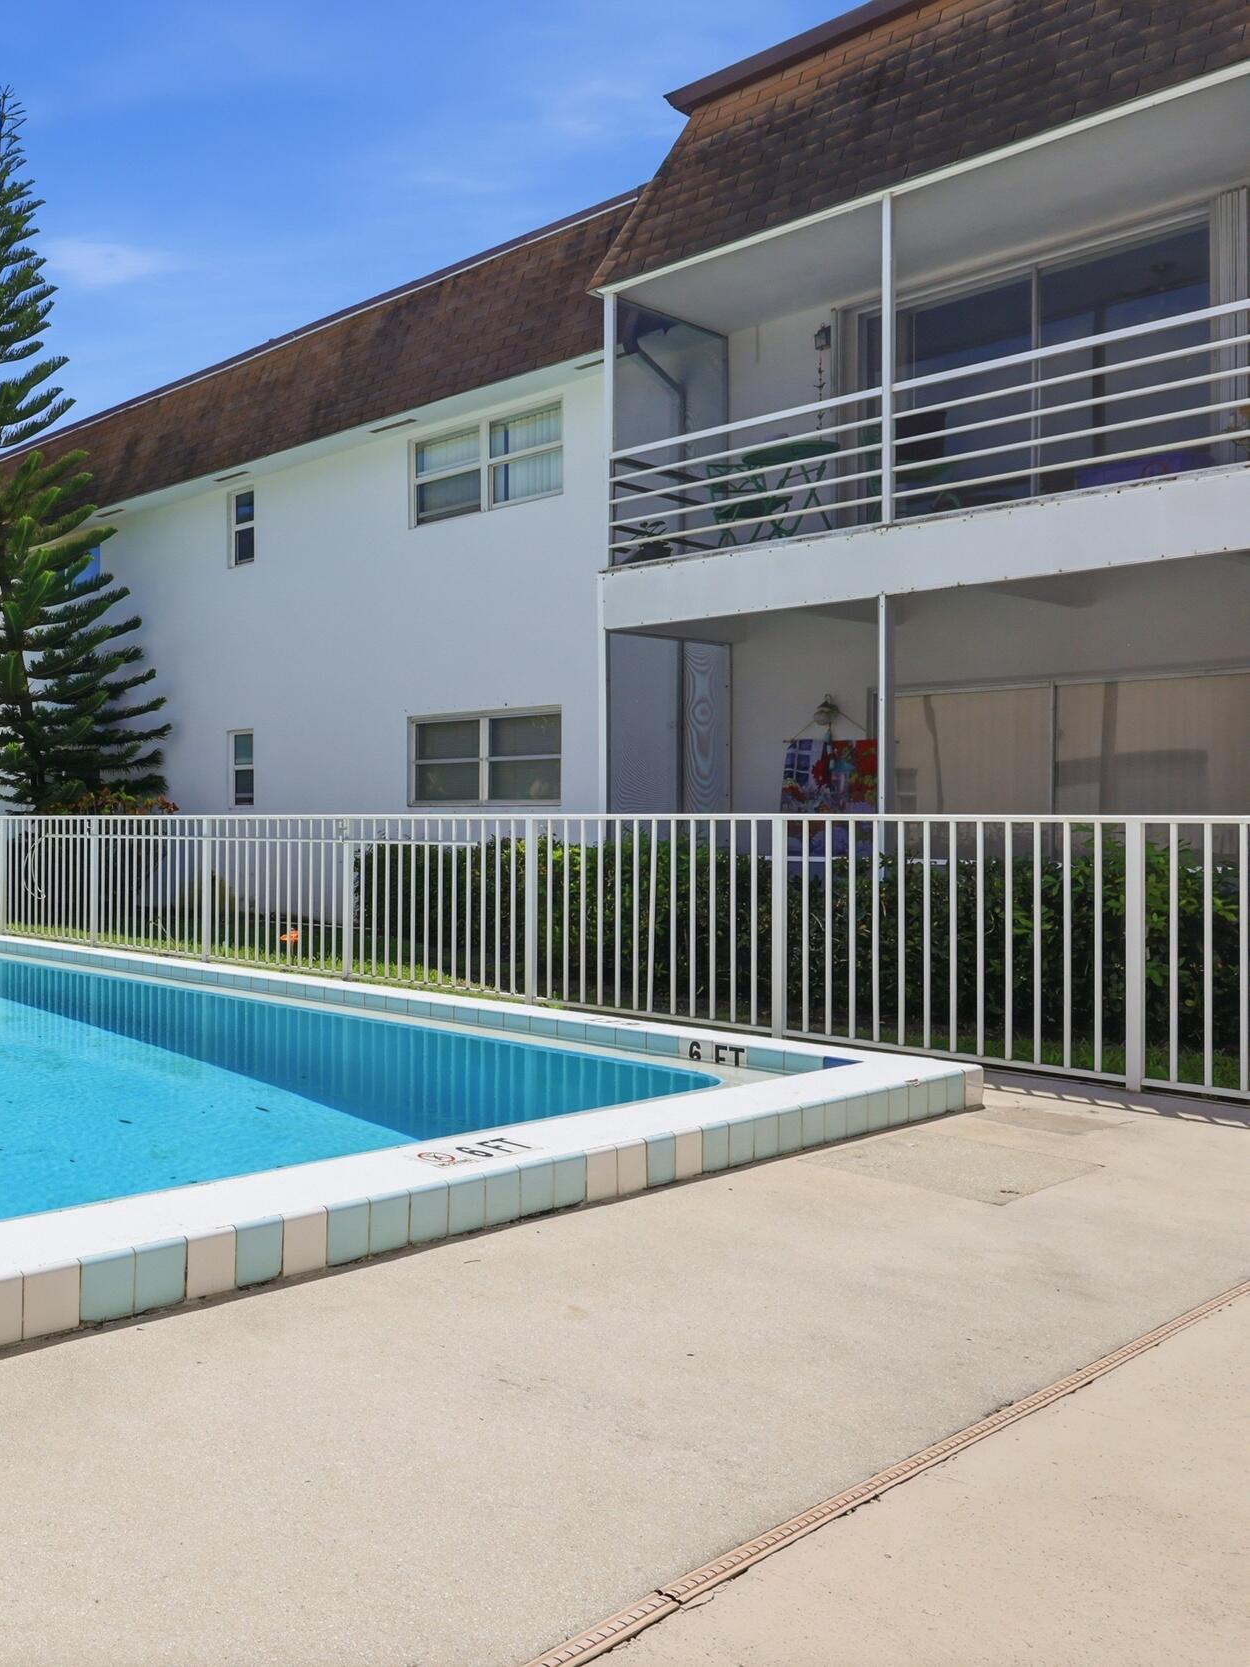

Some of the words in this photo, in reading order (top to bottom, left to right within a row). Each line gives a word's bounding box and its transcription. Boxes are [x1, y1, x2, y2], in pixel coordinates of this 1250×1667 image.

[689, 1041, 702, 1060] 6
[715, 1044, 745, 1067] FT
[455, 1147, 494, 1157] 6
[475, 1137, 532, 1153] FT
